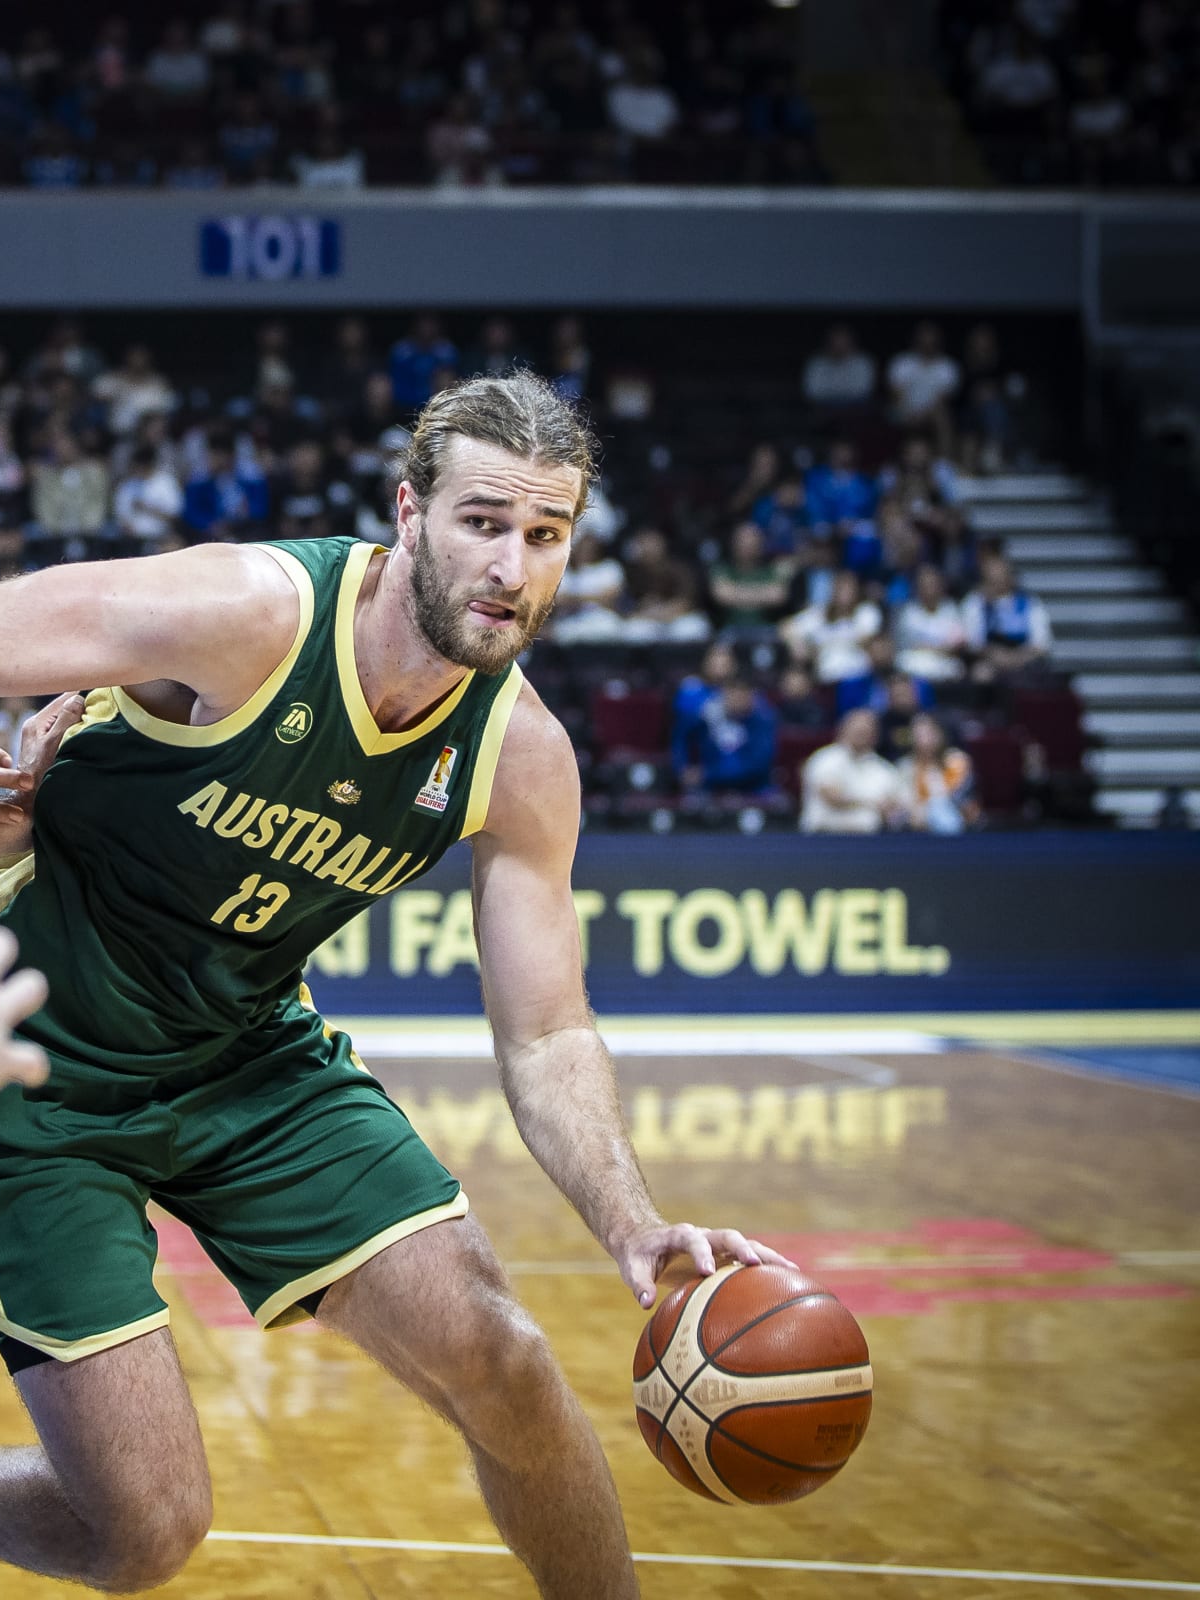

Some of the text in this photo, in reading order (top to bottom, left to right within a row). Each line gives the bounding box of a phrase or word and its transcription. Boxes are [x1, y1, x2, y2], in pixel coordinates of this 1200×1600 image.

[222, 215, 321, 278] 101
[210, 873, 291, 933] 13
[389, 888, 606, 977] FAT
[616, 887, 951, 978] TOWEL.
